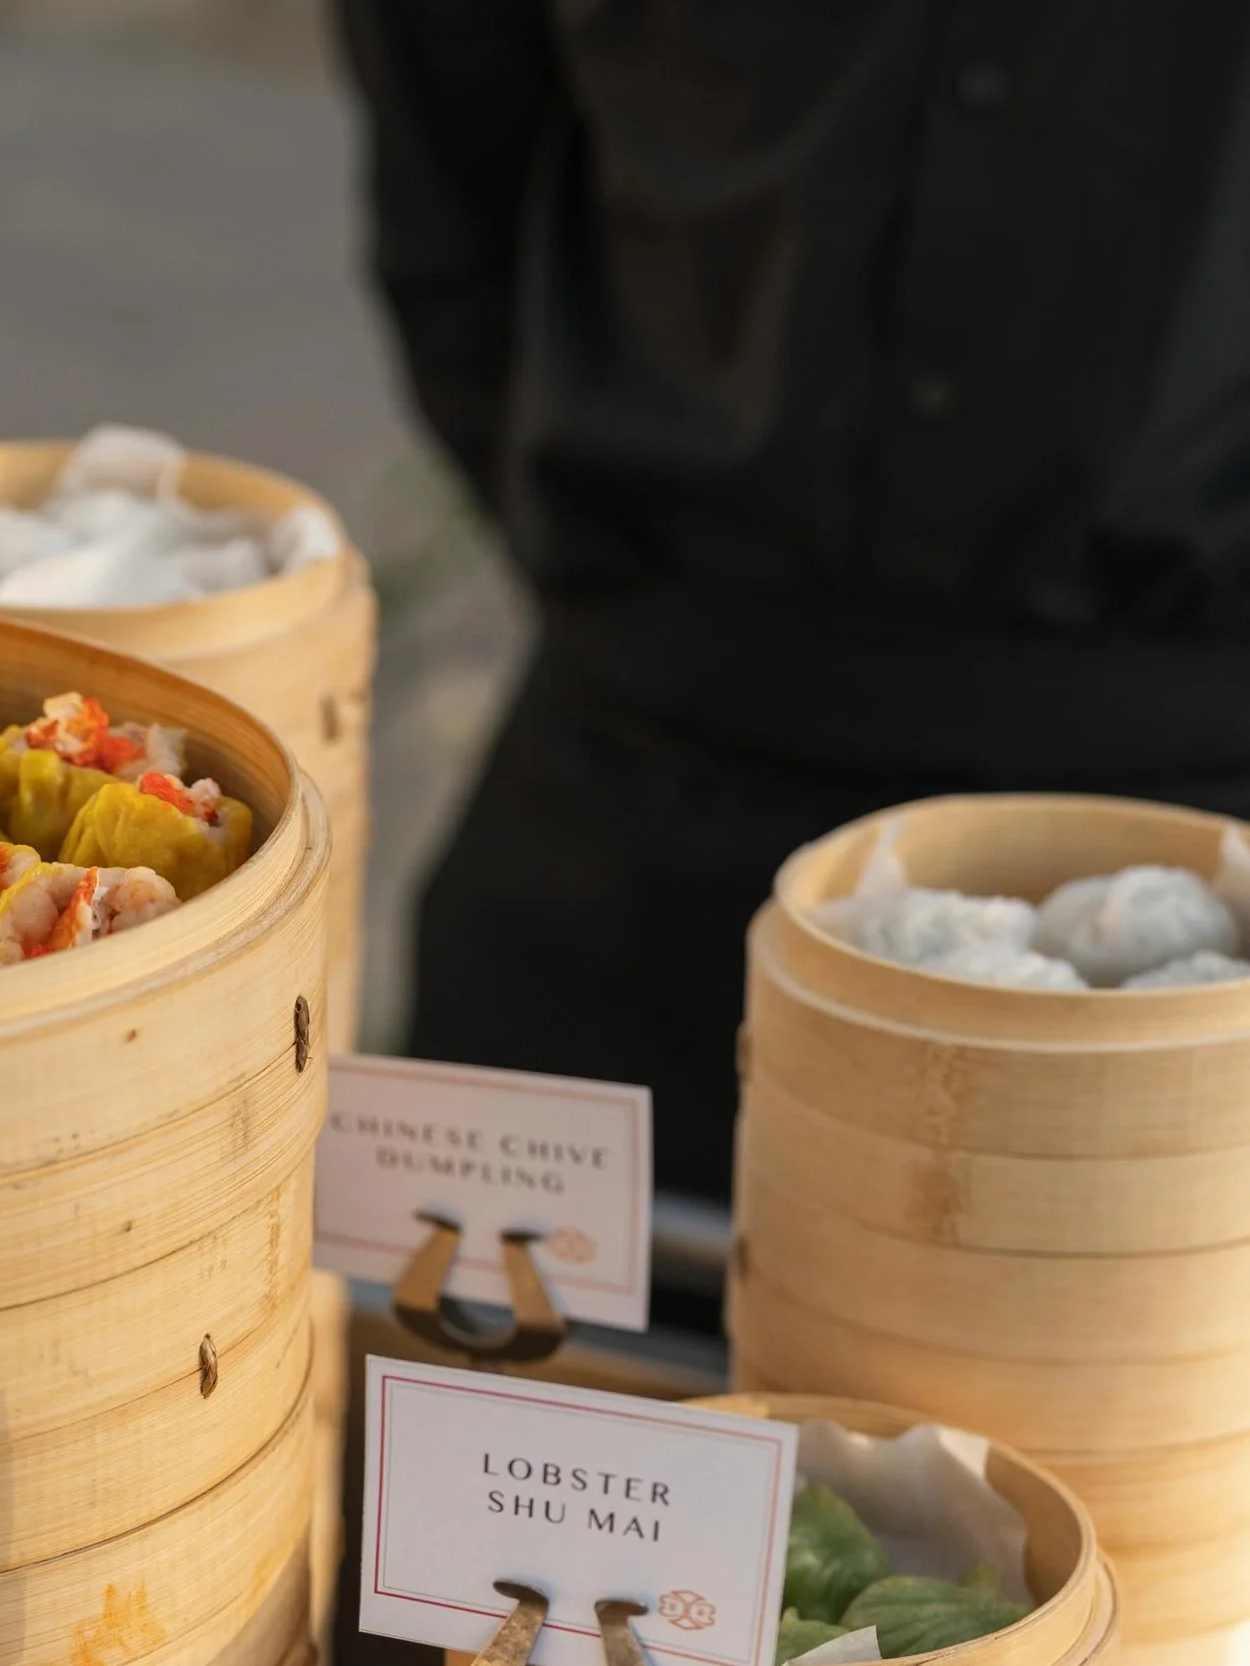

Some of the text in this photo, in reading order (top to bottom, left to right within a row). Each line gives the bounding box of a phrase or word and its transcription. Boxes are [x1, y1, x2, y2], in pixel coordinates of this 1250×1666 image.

[329, 1111, 609, 1169] CHINESE CHIVE
[375, 1145, 565, 1195] DUMPLING
[482, 1453, 670, 1507] LOBSTER
[488, 1490, 660, 1542] SHU MAI
